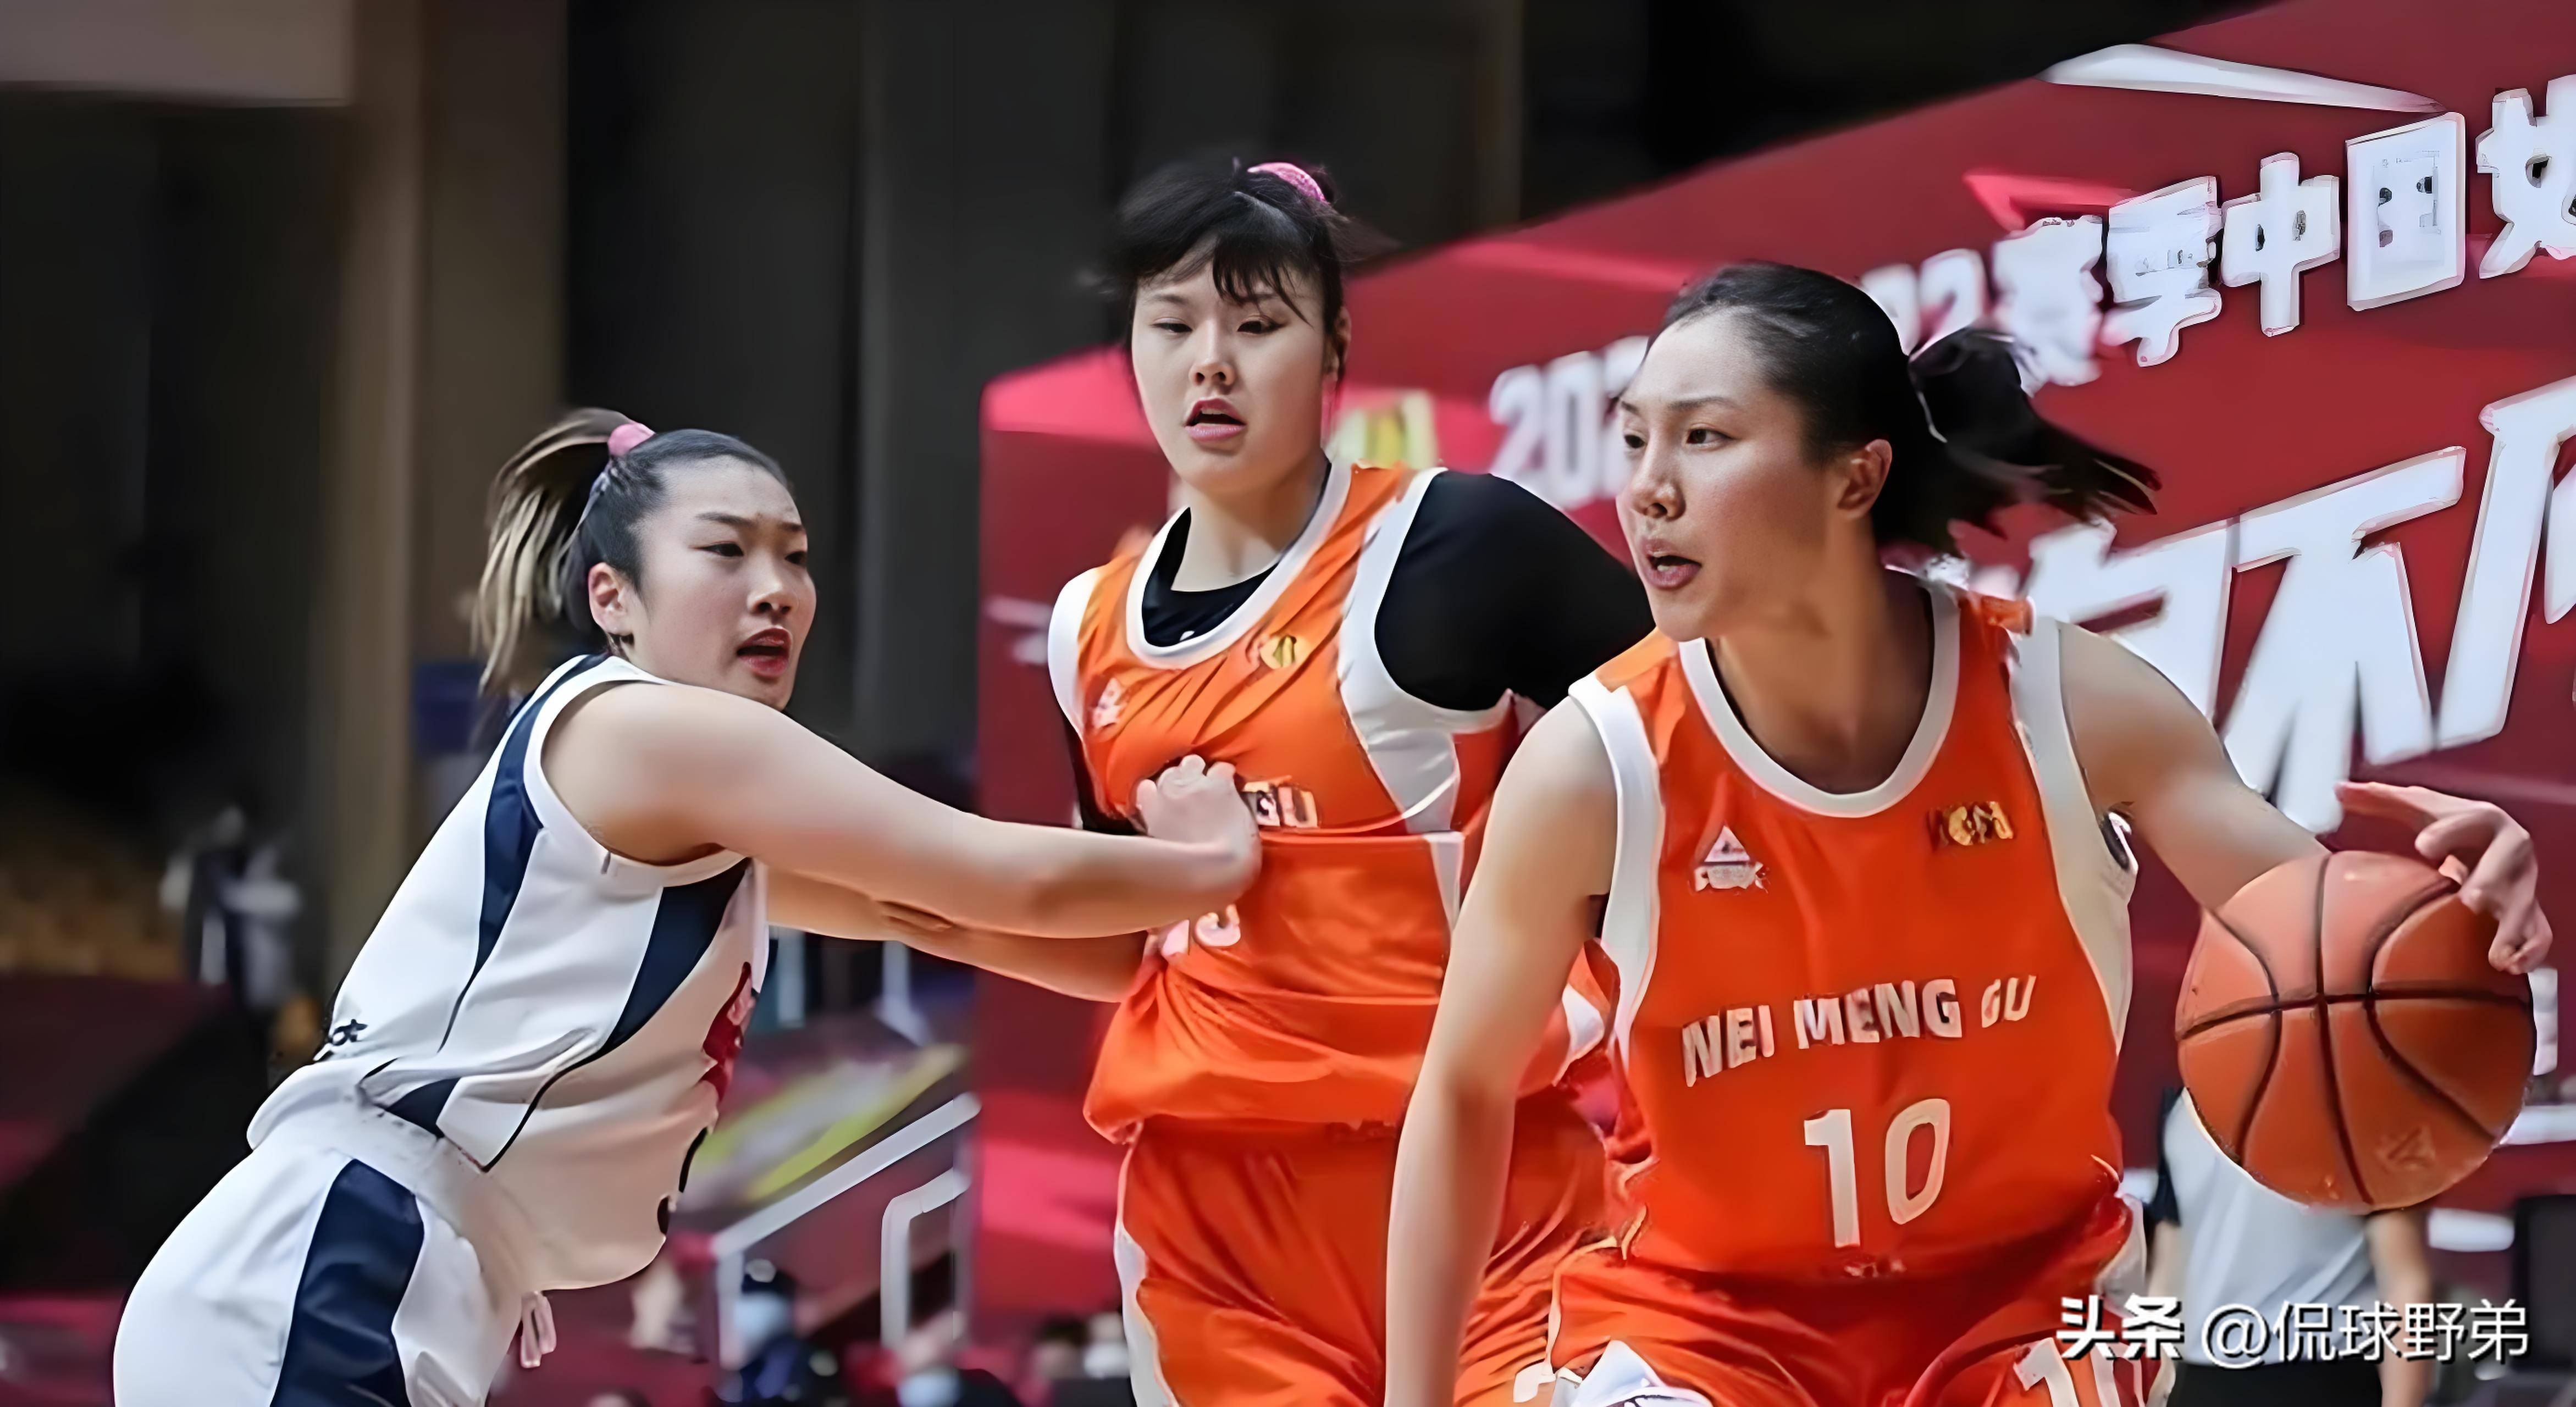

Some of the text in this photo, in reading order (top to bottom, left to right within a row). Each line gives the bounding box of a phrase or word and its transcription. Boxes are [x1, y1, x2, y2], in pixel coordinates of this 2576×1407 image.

[1682, 974, 2037, 1087] NEI MENG GU
[1804, 1098, 1950, 1248] 10
